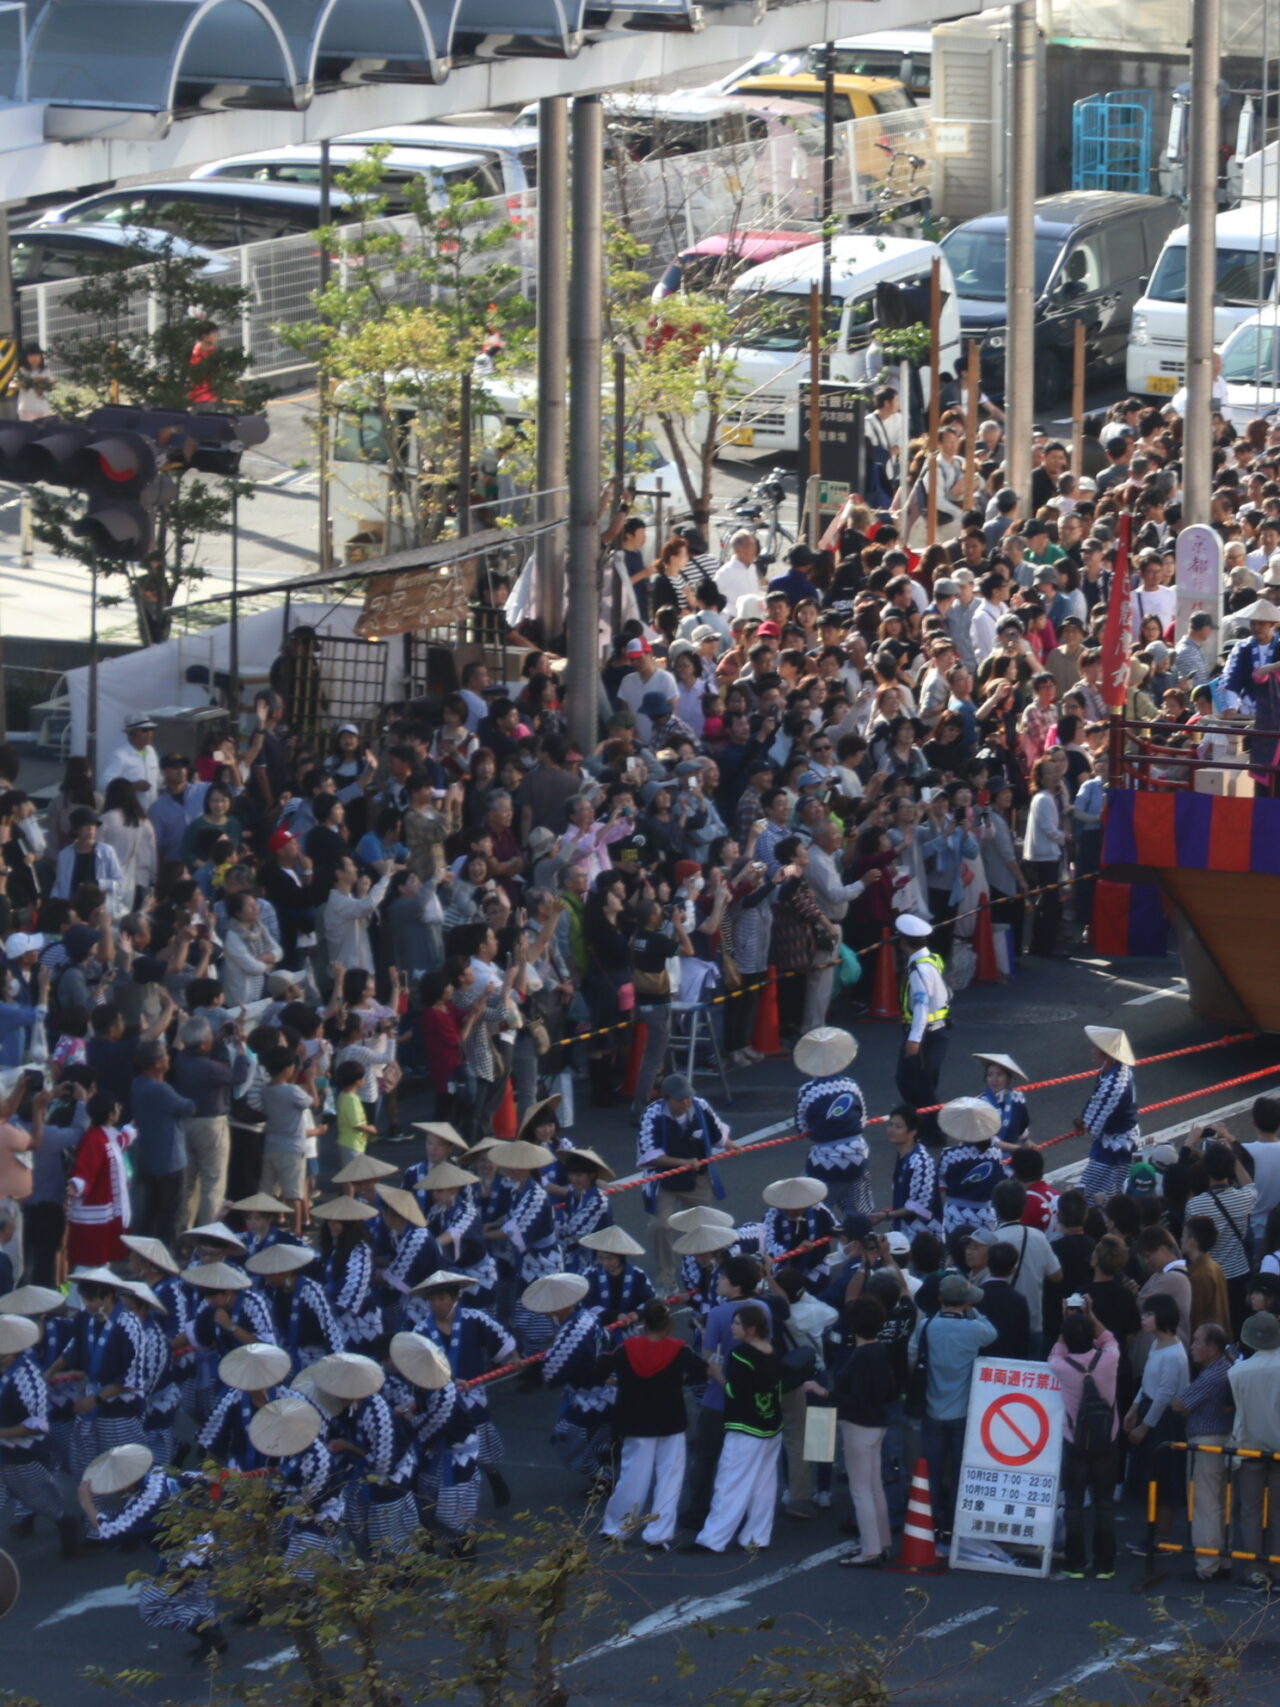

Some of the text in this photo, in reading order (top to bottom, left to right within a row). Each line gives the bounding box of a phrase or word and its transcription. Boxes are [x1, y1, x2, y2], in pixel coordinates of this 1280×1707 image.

[979, 1367, 1062, 1391] 車両通行禁止
[967, 1469, 999, 1483] 10月12日
[965, 1484, 997, 1498] 10月13日
[961, 1498, 985, 1513] 対象
[971, 1519, 1035, 1538] 津警察署長
